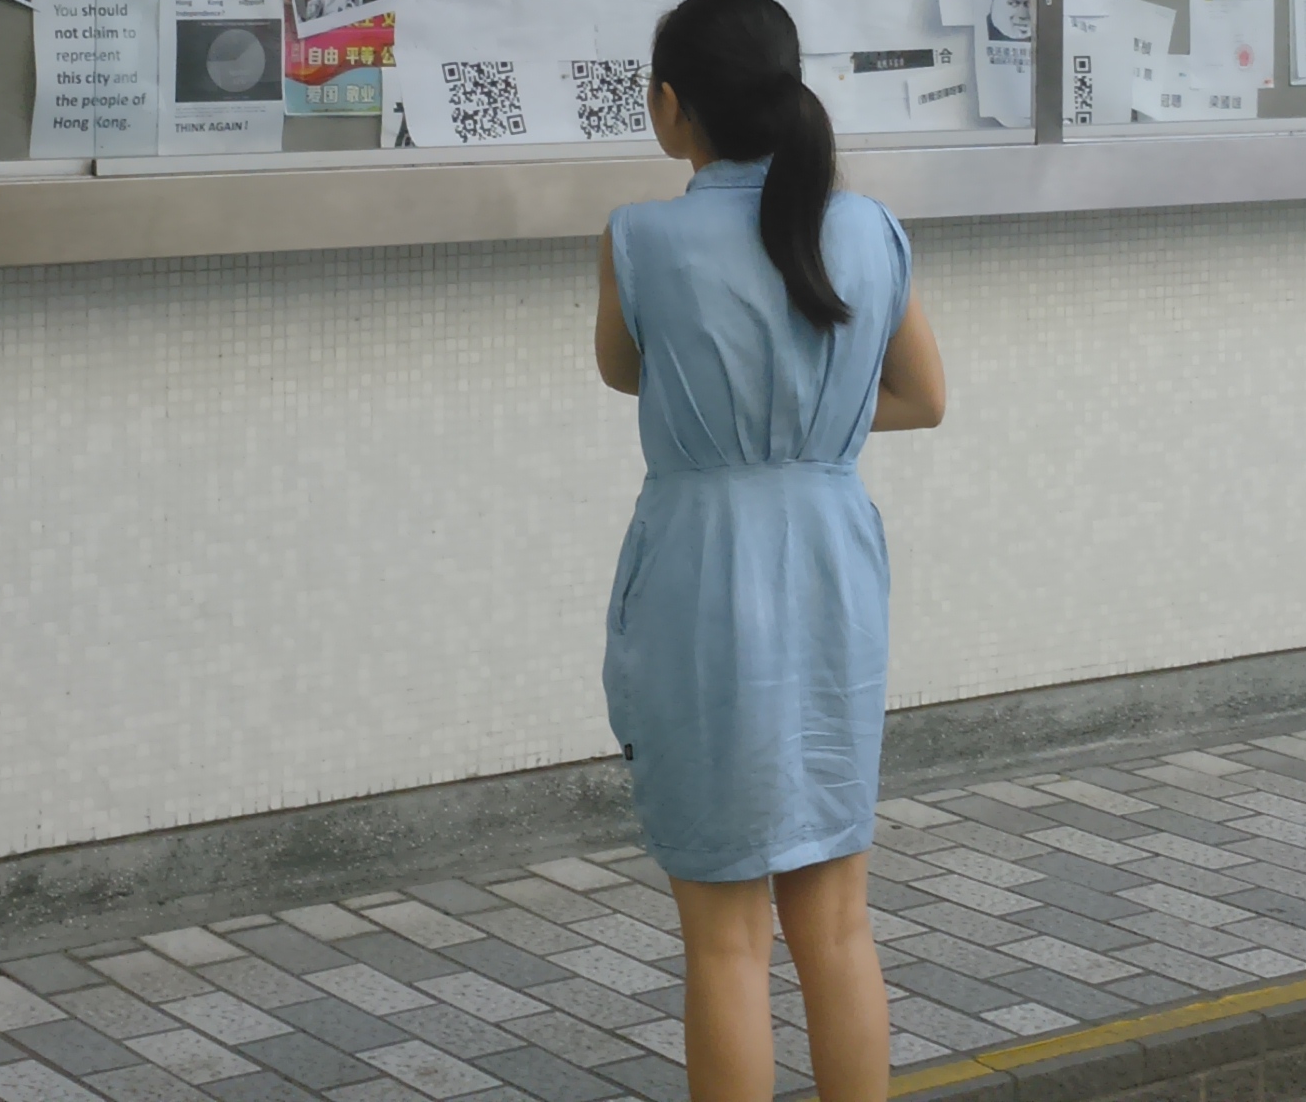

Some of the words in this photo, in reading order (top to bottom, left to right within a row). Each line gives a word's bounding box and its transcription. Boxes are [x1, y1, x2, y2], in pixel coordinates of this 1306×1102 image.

[54, 4, 78, 17] You
[82, 3, 128, 17] should
[55, 28, 79, 39] not
[82, 26, 119, 39] claim
[123, 28, 136, 39] to
[56, 51, 121, 64] represent
[308, 47, 338, 65] 自由
[346, 47, 374, 65] 平等
[57, 72, 82, 85] this
[85, 72, 110, 86] city
[113, 71, 138, 84] and
[56, 94, 78, 106] the
[82, 93, 129, 109] people
[132, 92, 147, 106] of
[53, 117, 90, 131] Hong
[94, 117, 131, 131] Kong.
[175, 123, 206, 133] THINK
